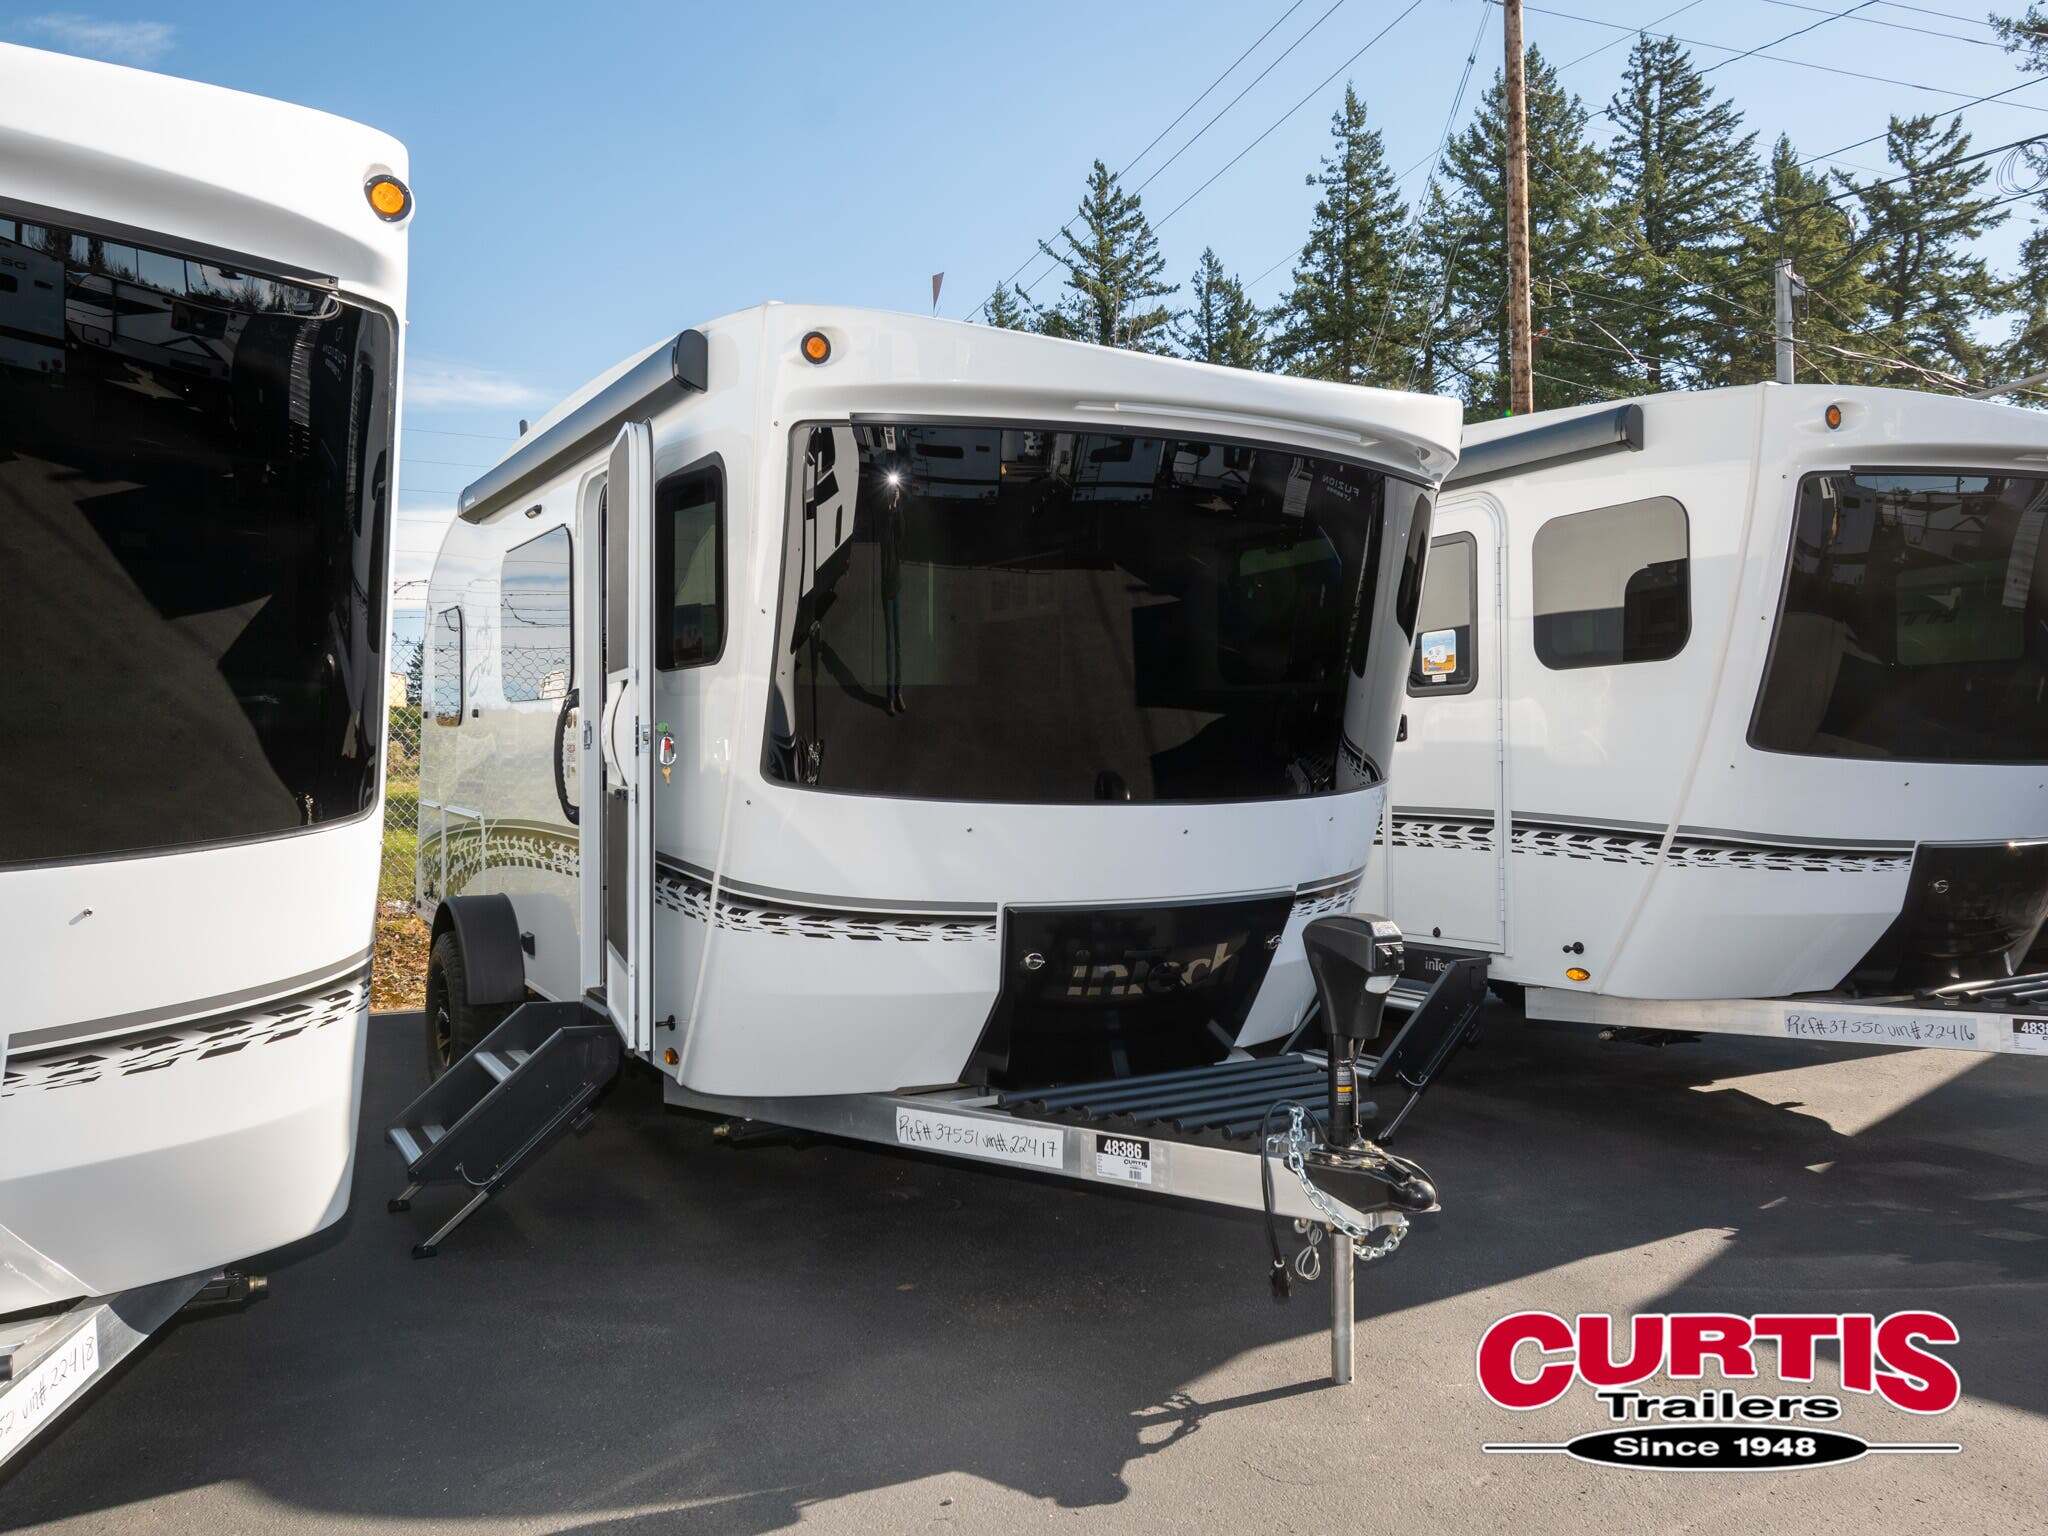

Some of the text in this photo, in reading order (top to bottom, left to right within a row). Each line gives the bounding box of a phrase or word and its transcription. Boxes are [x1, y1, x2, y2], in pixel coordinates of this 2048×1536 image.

[1829, 1017, 1884, 1034] 37550
[1923, 1022, 1976, 1041] 22416
[2021, 1021, 2048, 1035] 483
[934, 1123, 978, 1146] 37551
[1010, 1135, 1057, 1158] 22417
[1103, 1138, 1142, 1159] 48386
